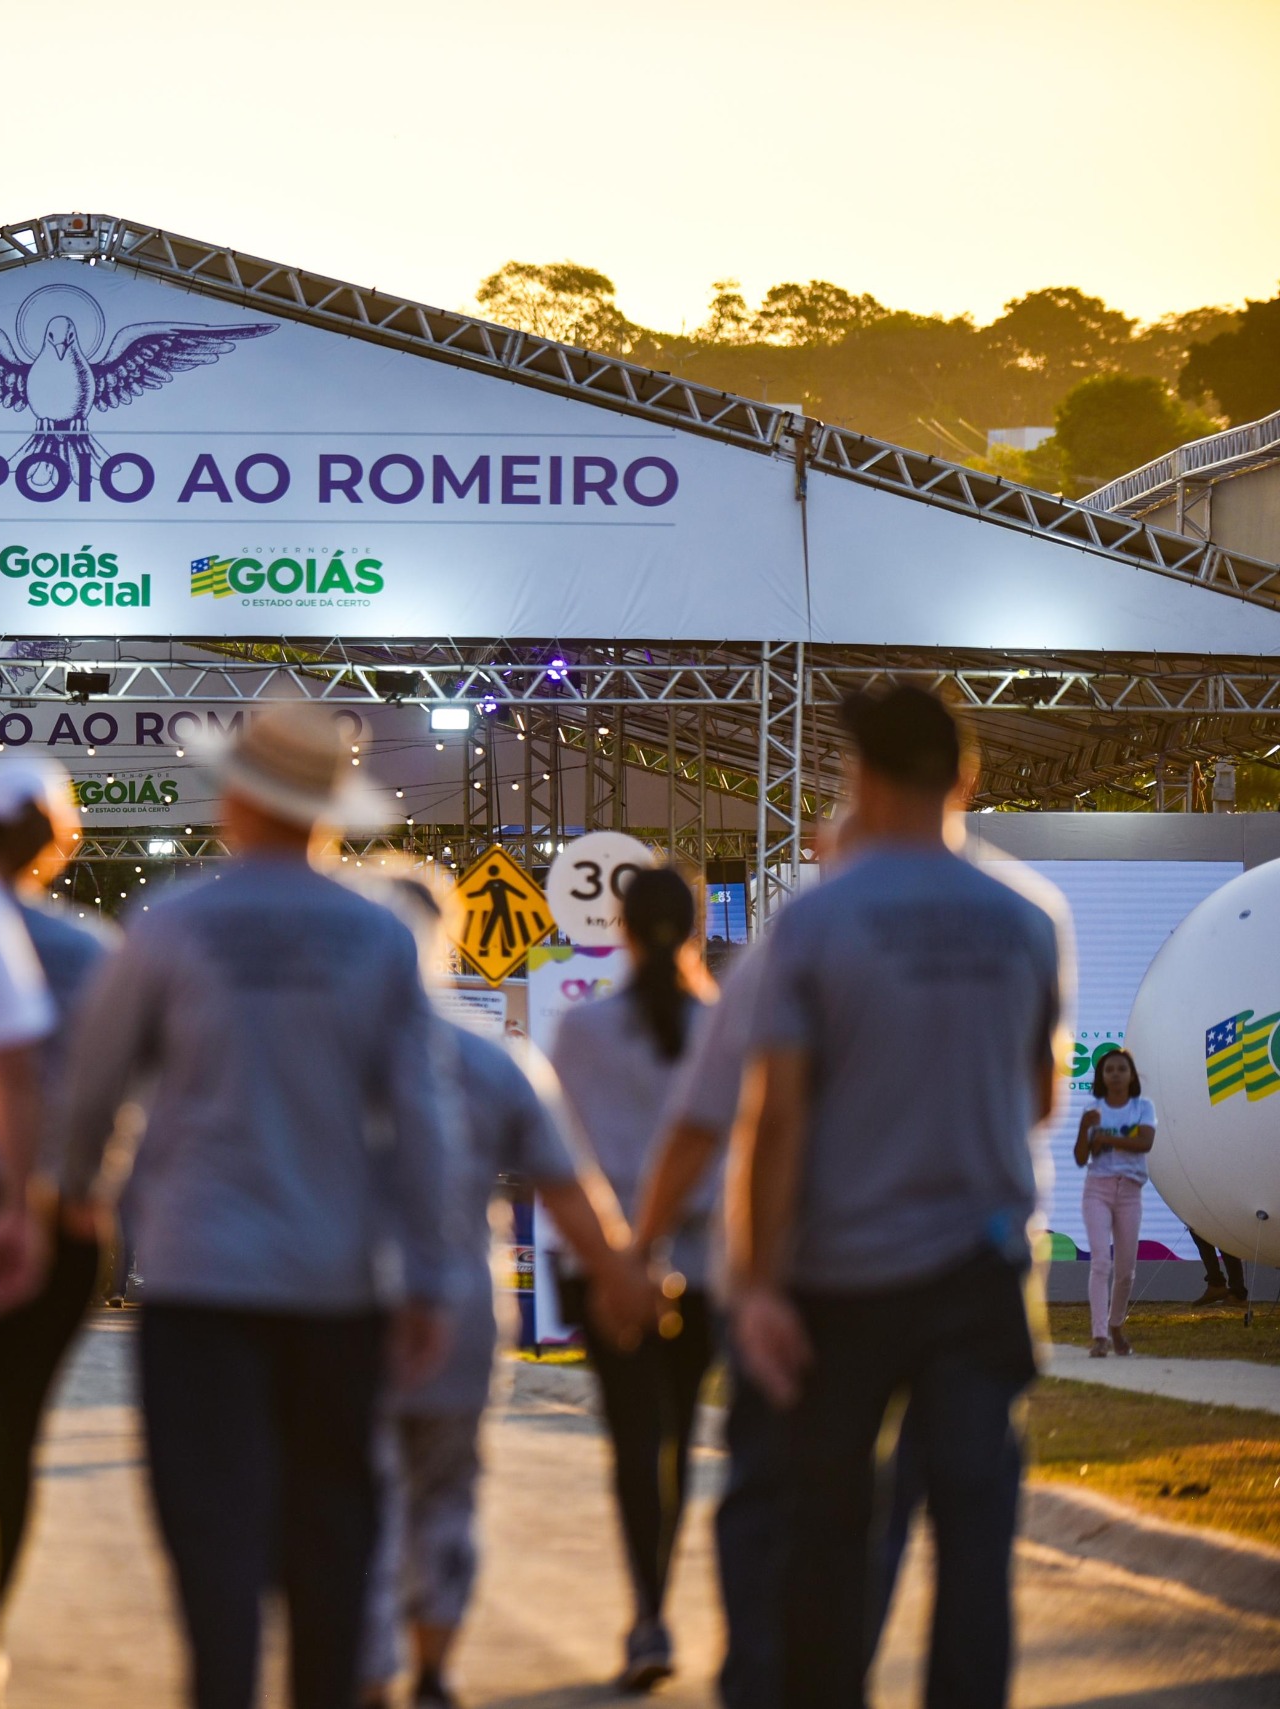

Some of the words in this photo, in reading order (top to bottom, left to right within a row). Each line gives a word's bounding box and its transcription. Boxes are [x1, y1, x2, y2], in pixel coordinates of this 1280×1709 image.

[177, 452, 291, 504] AO
[319, 454, 679, 507] ROMEIRO
[242, 546, 329, 554] GOVERNO
[228, 549, 384, 595] GOIÁS
[27, 574, 151, 608] social
[241, 599, 250, 607] O
[252, 599, 294, 607] ESTADO
[295, 599, 318, 608] QUE
[319, 597, 335, 607] DÁ
[336, 599, 371, 607] CERTO
[47, 712, 118, 747] AO
[80, 774, 179, 805] GOIÁS
[570, 861, 642, 901] 30
